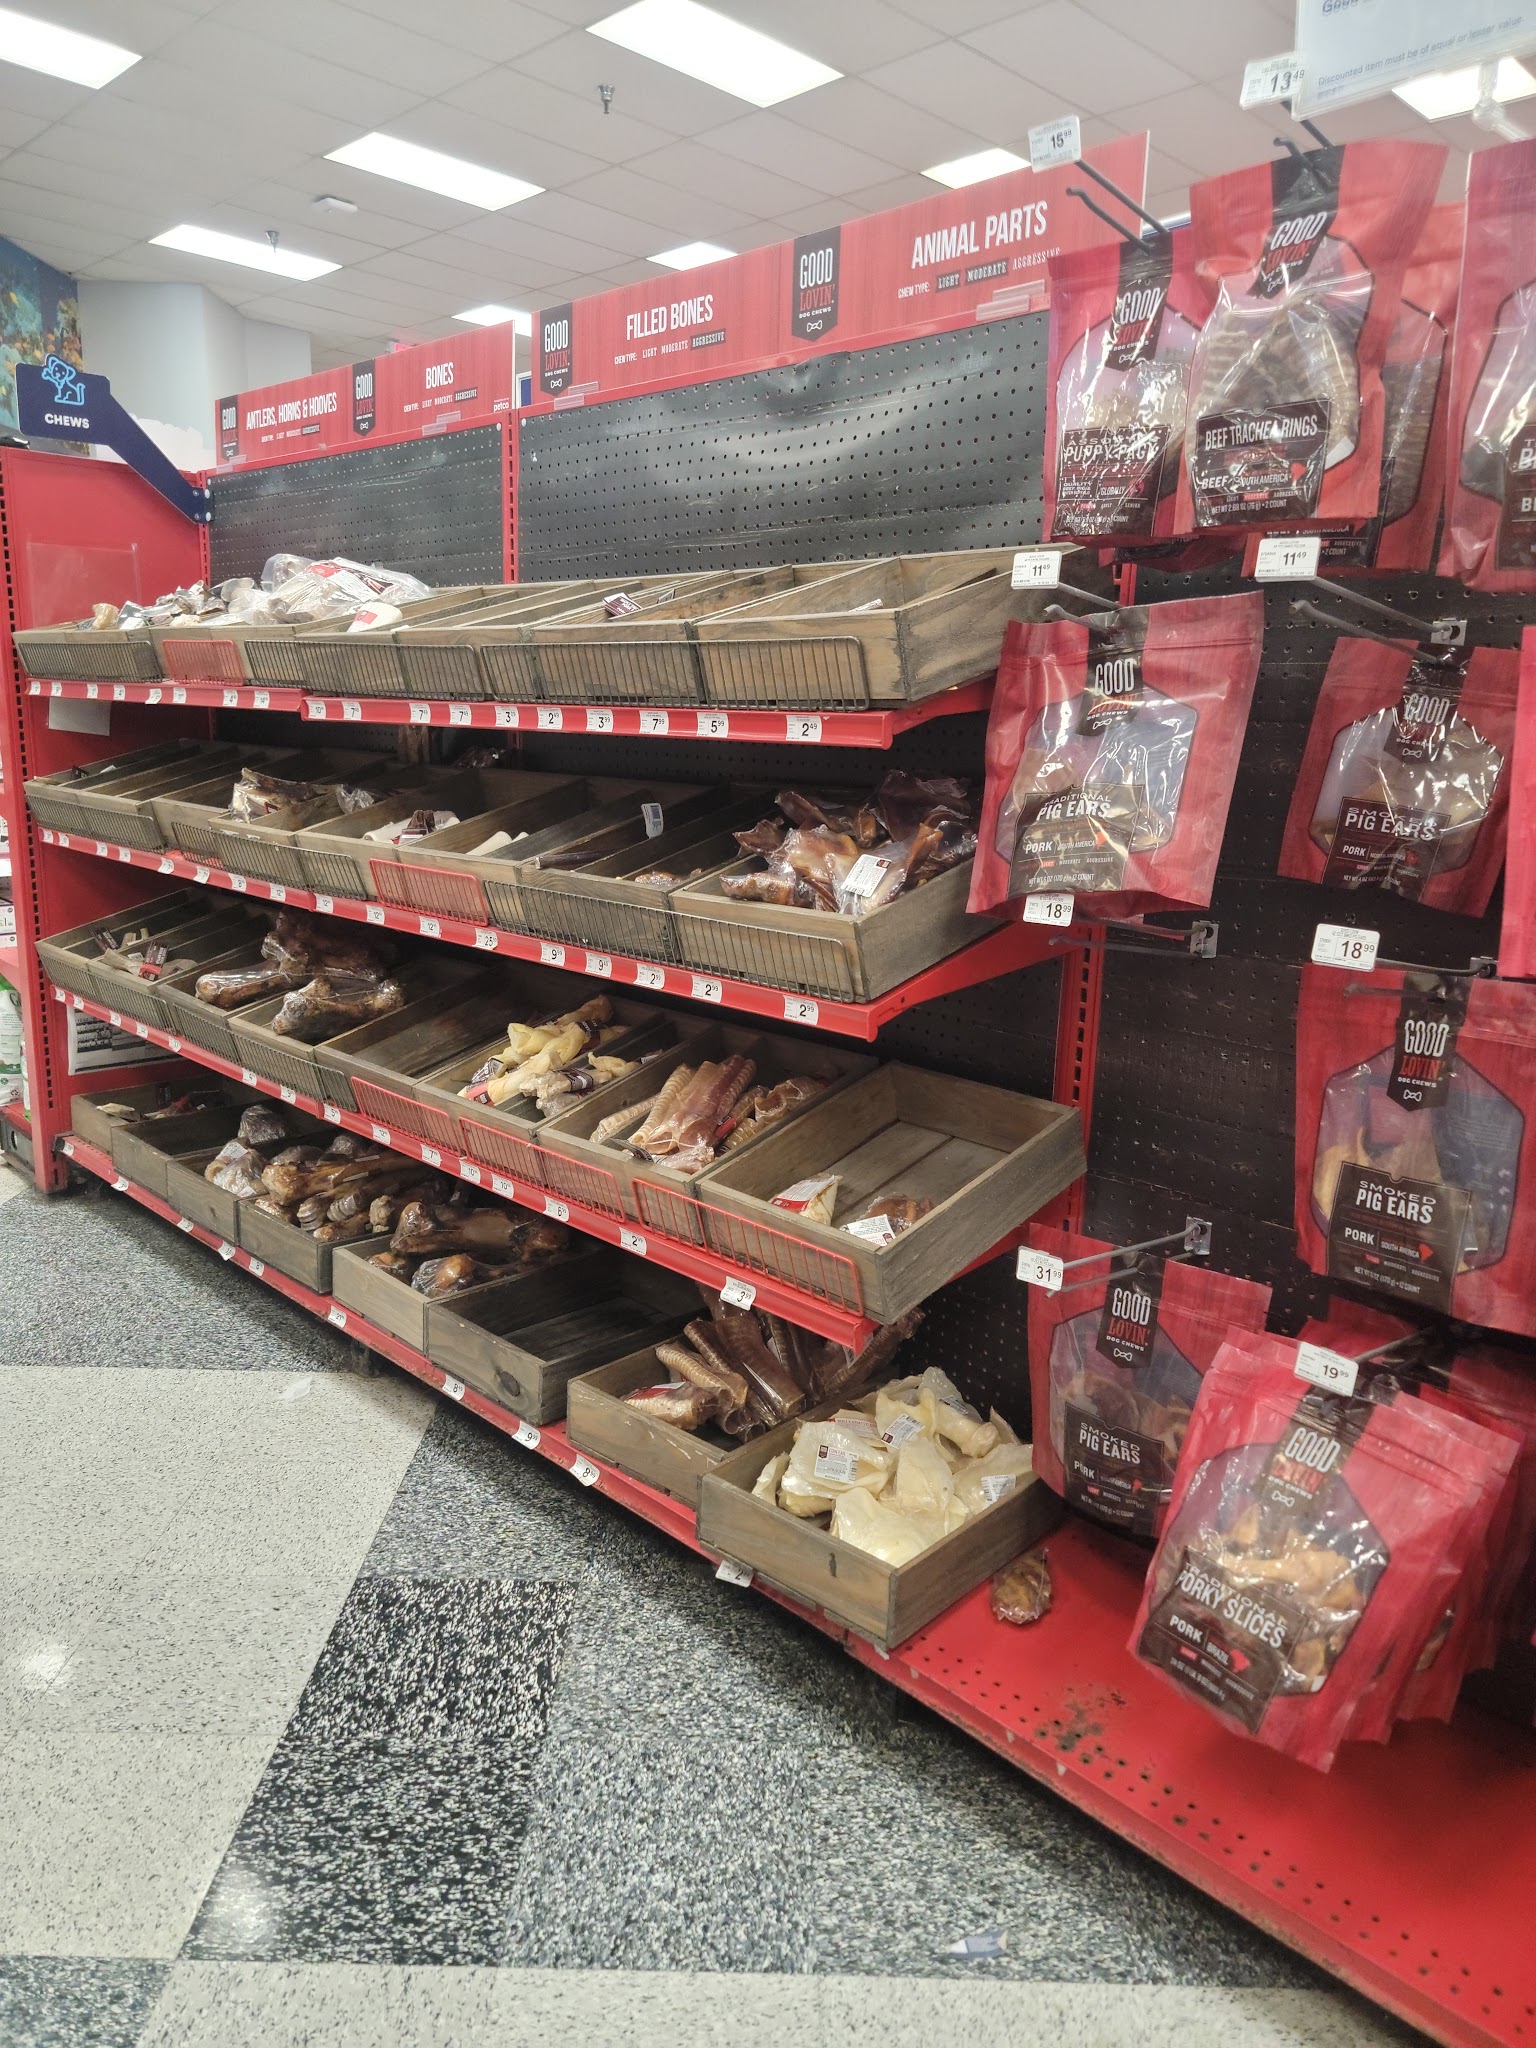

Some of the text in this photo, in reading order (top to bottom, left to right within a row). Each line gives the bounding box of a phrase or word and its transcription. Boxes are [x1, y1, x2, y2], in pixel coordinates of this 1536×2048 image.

[1318, 66, 1363, 87] Discounted
[1364, 60, 1384, 73] item
[1385, 52, 1405, 66] must
[1407, 48, 1418, 58] be
[1419, 43, 1430, 55] of
[1431, 37, 1455, 53] equal
[1457, 33, 1467, 43] or
[1468, 23, 1496, 40] lesser
[911, 200, 1048, 269] ANIMAL PARTS
[1270, 211, 1328, 250] GOOD
[800, 248, 833, 290] GOOD
[897, 285, 913, 299] CHEW
[914, 282, 930, 296] TYPE:
[938, 273, 959, 289] LIGHT
[967, 262, 1007, 282] MODERATE
[626, 294, 713, 340] FILLED BONES
[811, 307, 831, 316] CHEWS
[1120, 287, 1161, 325] GOOD
[544, 319, 568, 352] GOOD
[642, 347, 657, 358] LIGHT
[661, 340, 688, 355] MODERATE
[692, 332, 725, 348] AGGRESSIVE
[355, 372, 373, 400] GOOD
[425, 361, 454, 389] BONES
[44, 413, 90, 429] CHEWS
[222, 406, 236, 430] GOOD
[246, 392, 337, 431] ANTLERS, HORNS & HOOVES
[493, 402, 510, 413] petco
[1205, 415, 1318, 451] BEEF TRACHEA RINGS
[1064, 445, 1113, 462] PUPPY
[1202, 476, 1229, 489] BEEF
[1259, 473, 1288, 486] AMERICA
[1269, 499, 1287, 509] COUNT
[1094, 658, 1135, 696] GOOD
[1404, 693, 1450, 725] GOOD
[1036, 800, 1111, 821] PIG EARS
[1345, 812, 1435, 841] PIG EARS
[1025, 841, 1053, 854] PORK
[1074, 840, 1095, 849] AMERICA
[1342, 845, 1366, 857] PORK
[1077, 873, 1095, 882] COUNT
[1404, 1019, 1450, 1057] GOOD
[1397, 1076, 1437, 1088] DOG CHEWS
[1355, 1188, 1434, 1224] PIG EARS
[1359, 1180, 1437, 1205] SMOKED
[1345, 1226, 1420, 1259] PORK SOUTH AMERICA
[1112, 1287, 1151, 1326] GOOD
[1106, 1335, 1144, 1352] DOG CHEWS
[1079, 1429, 1141, 1465] PIG EARS
[1080, 1422, 1140, 1451] SMOKED
[1284, 1427, 1341, 1473] GOOD
[1074, 1460, 1095, 1479] PORK
[1175, 1570, 1286, 1648] PORKY SLICES
[1185, 1562, 1288, 1630] TRADITIONAL
[1169, 1615, 1204, 1643] PORK
